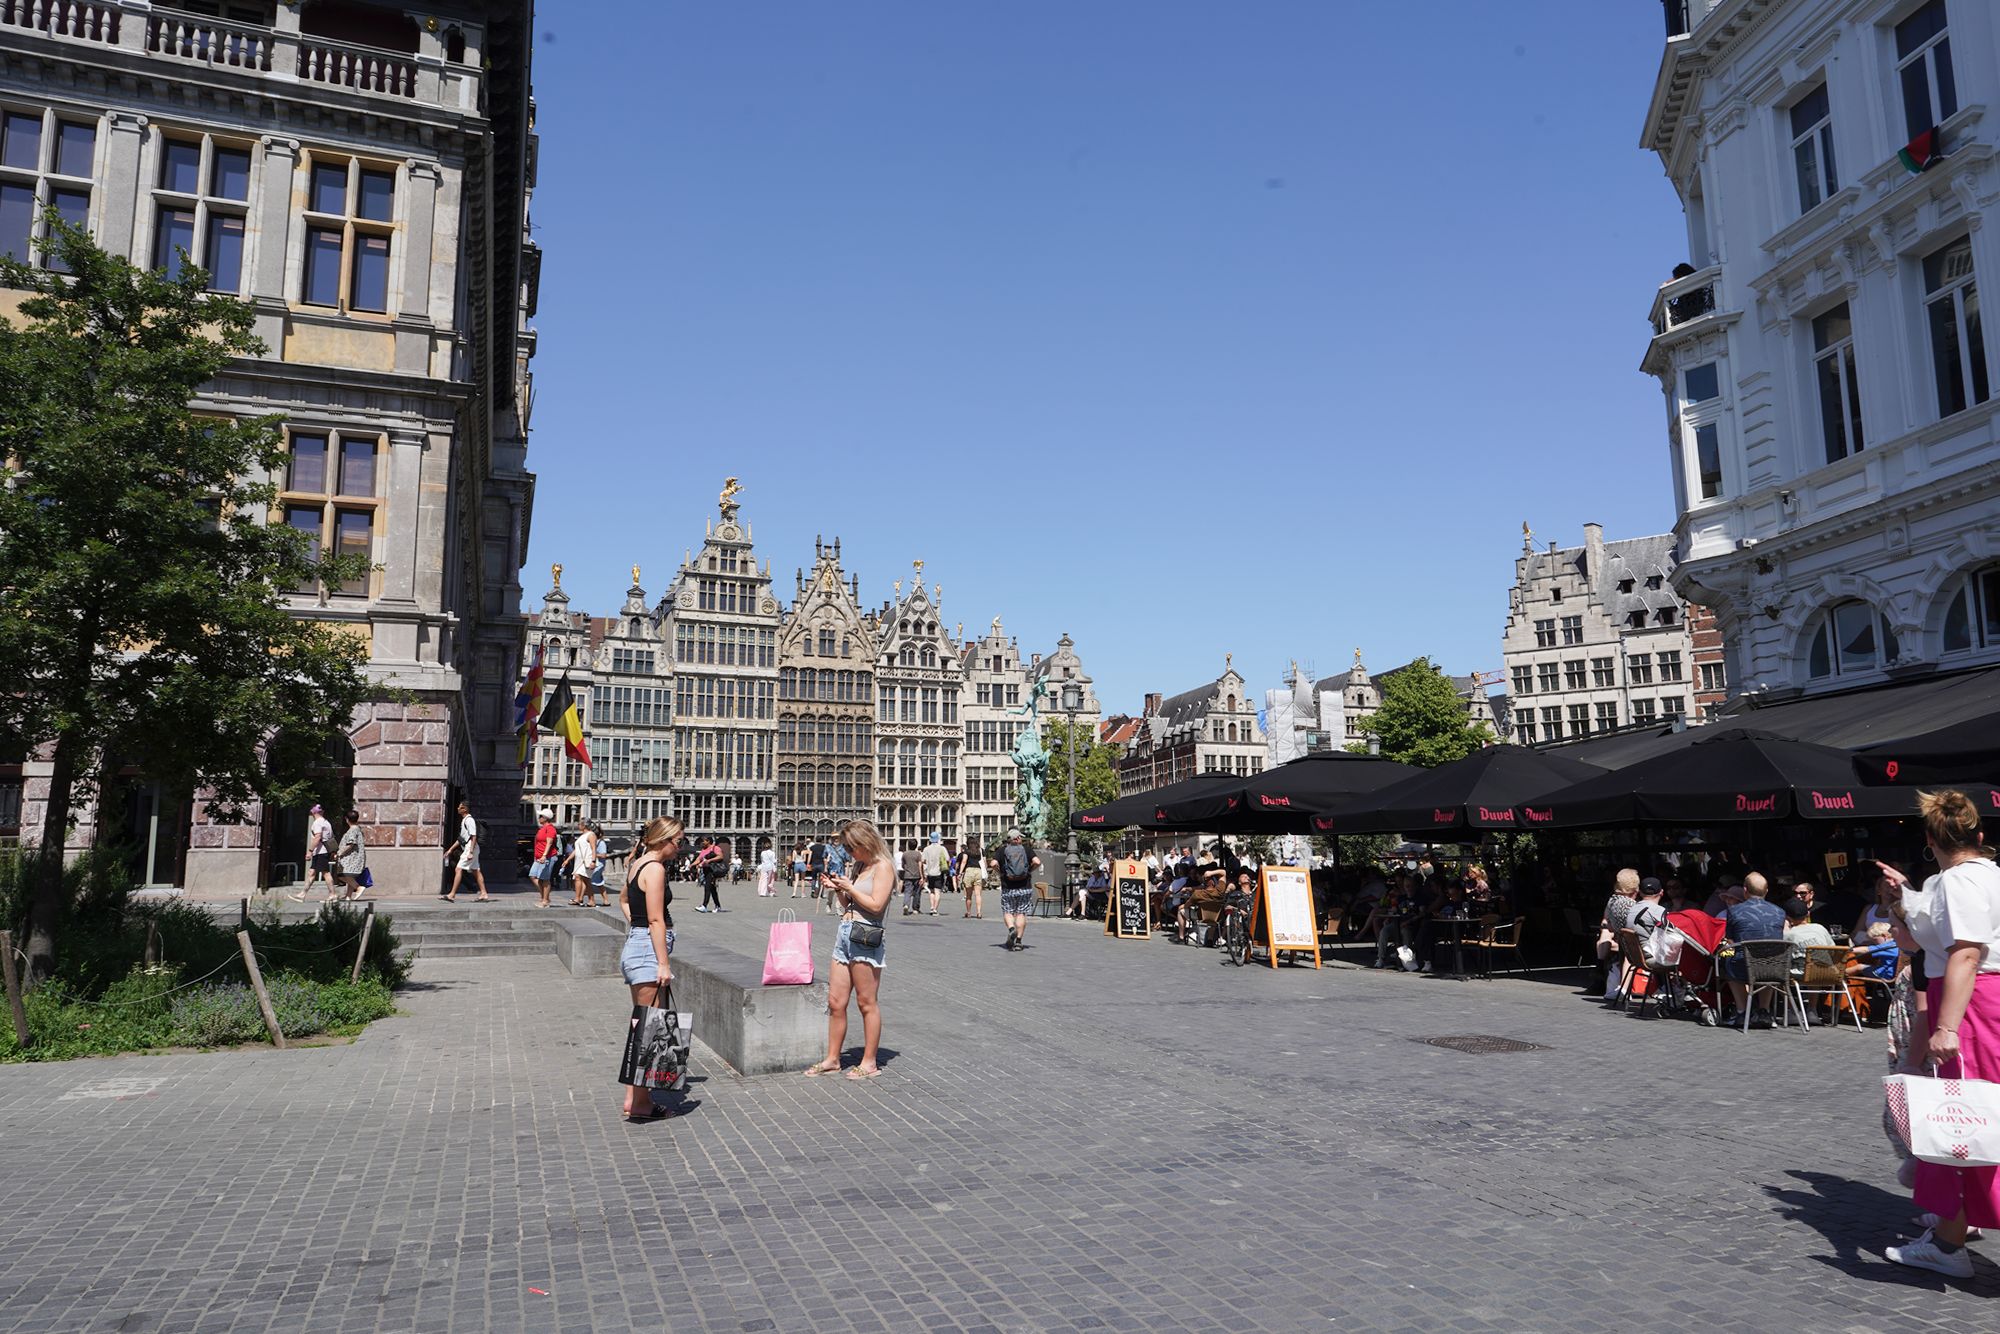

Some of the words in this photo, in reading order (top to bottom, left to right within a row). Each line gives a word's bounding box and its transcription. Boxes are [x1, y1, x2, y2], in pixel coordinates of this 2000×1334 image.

[1261, 794, 1291, 806] Duvel
[1736, 794, 1776, 811] Duvel
[1812, 791, 1855, 809] Duvel
[1082, 815, 1105, 823] Duvel
[1479, 806, 1515, 821] Duvel
[1946, 1106, 1963, 1114] DA
[1926, 1114, 1987, 1126] GIOVANNI
